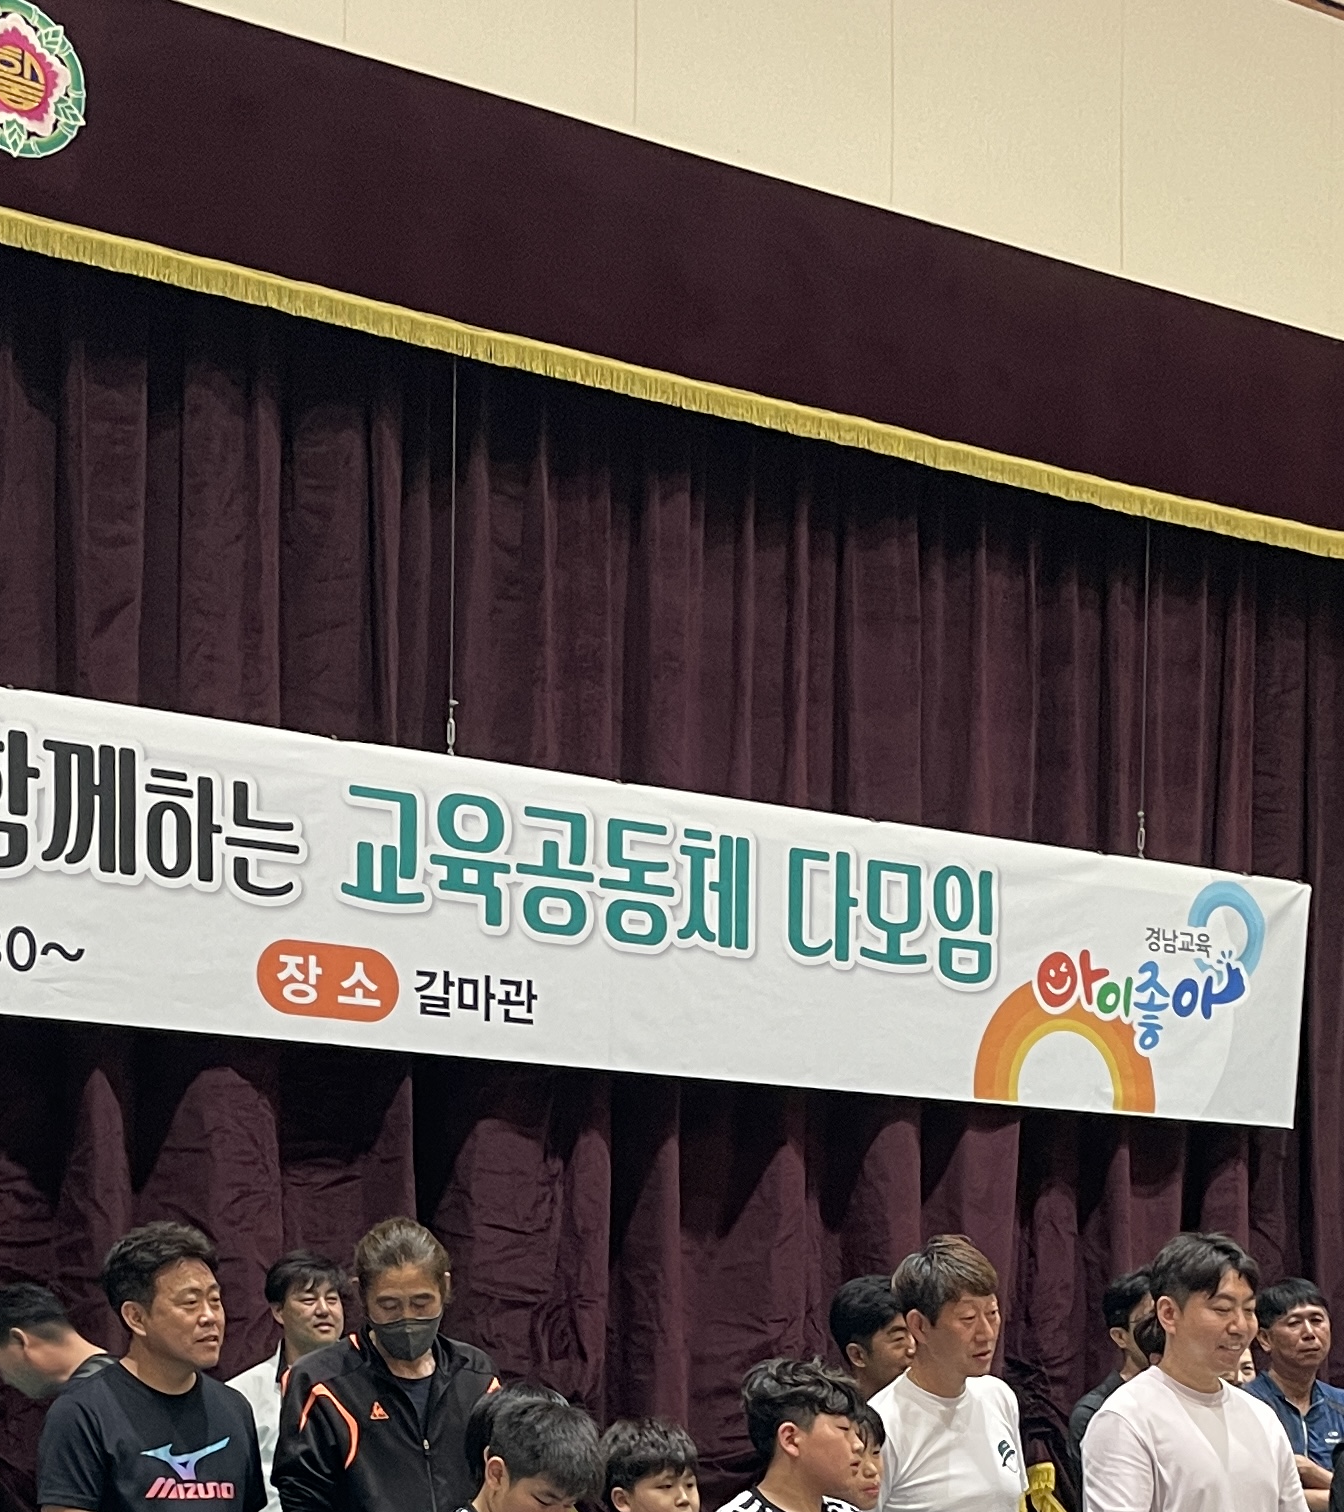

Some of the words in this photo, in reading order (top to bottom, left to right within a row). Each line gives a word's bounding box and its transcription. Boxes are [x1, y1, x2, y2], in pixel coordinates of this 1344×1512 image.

[342, 784, 749, 950] 교육공동체
[789, 848, 993, 983] 다모임
[1145, 926, 1212, 958] 경남교육
[415, 970, 537, 1025] 갈마관
[1037, 949, 1245, 1050] 아이좋아
[145, 1476, 235, 1499] MIZUNO
